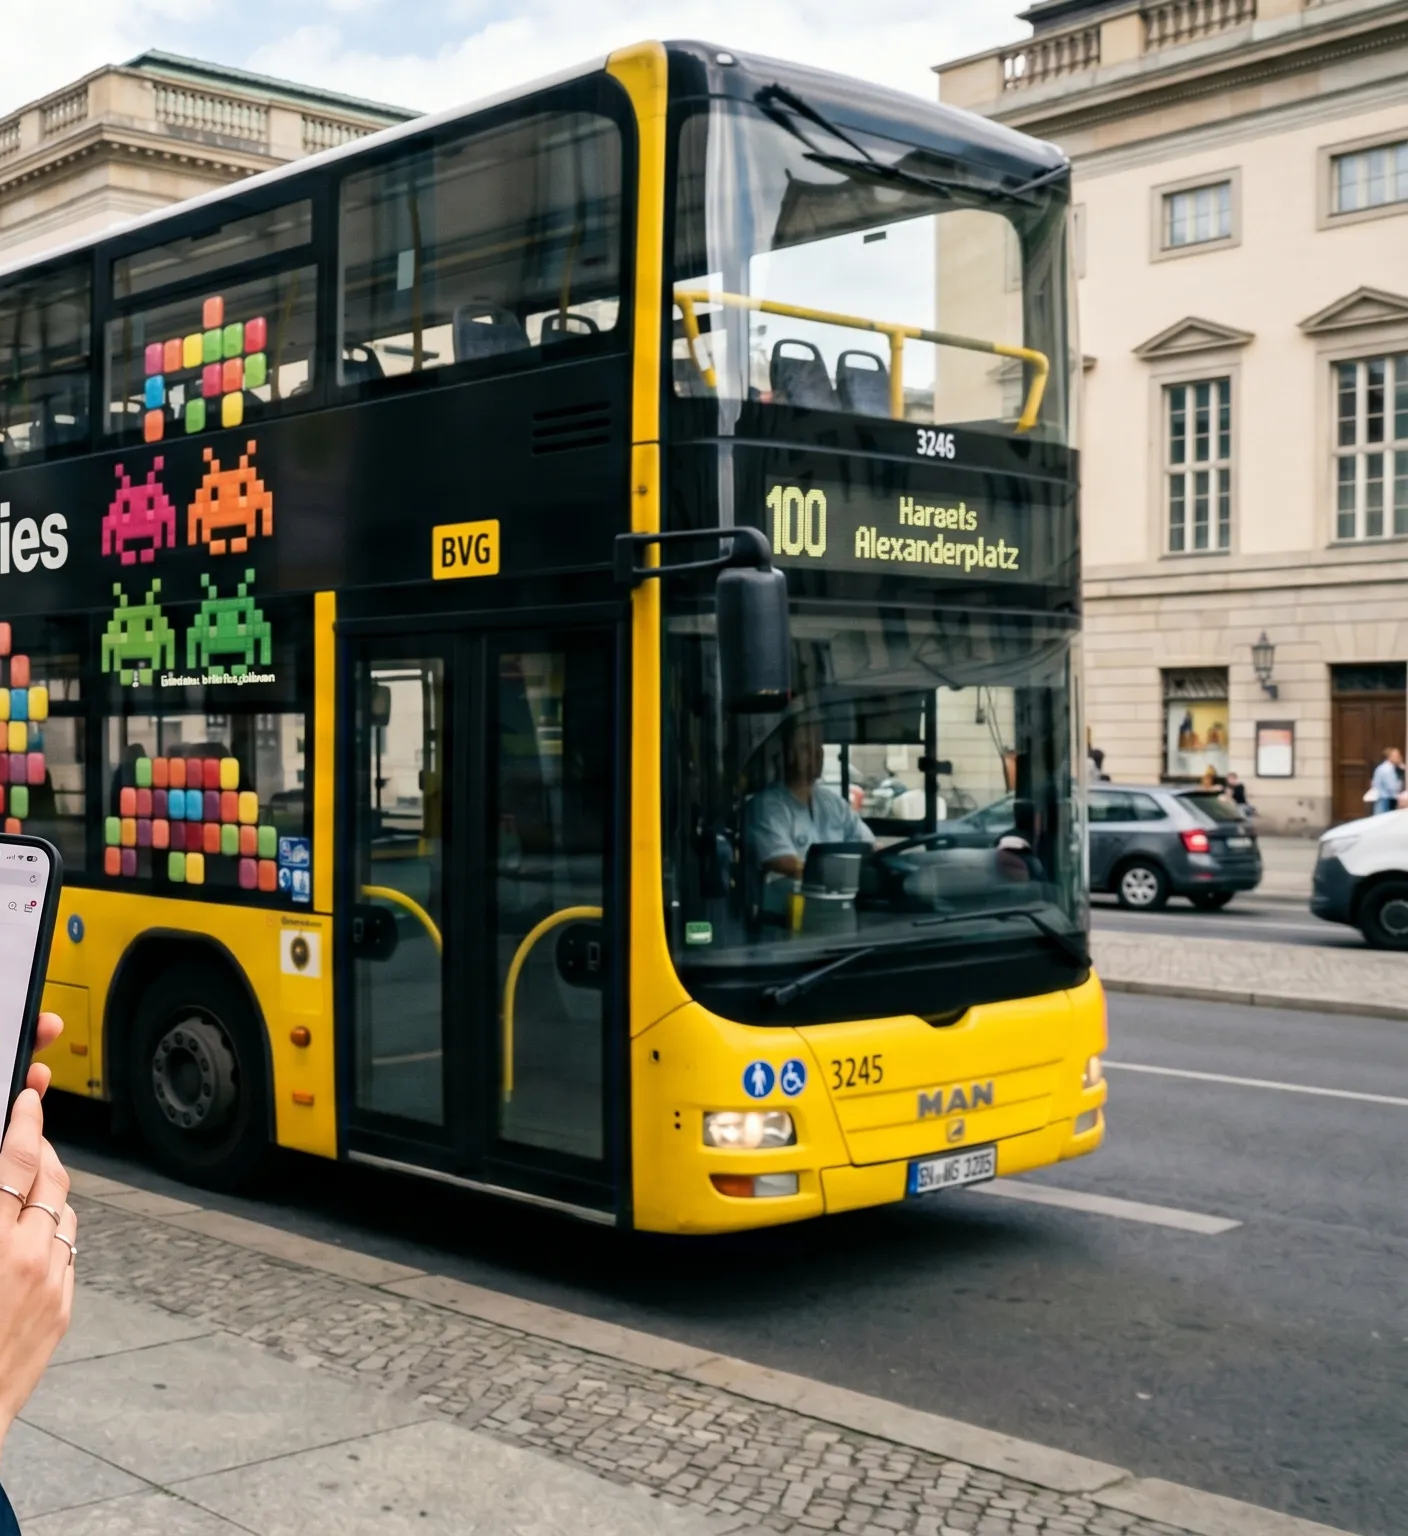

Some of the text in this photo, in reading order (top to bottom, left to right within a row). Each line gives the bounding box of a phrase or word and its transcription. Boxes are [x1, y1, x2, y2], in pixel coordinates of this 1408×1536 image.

[916, 429, 956, 459] 3246
[766, 485, 827, 557] 100
[441, 532, 491, 568] BVG
[855, 526, 1020, 573] Alexanderplatz
[831, 1054, 884, 1090] 3245
[917, 1079, 994, 1119] MAN
